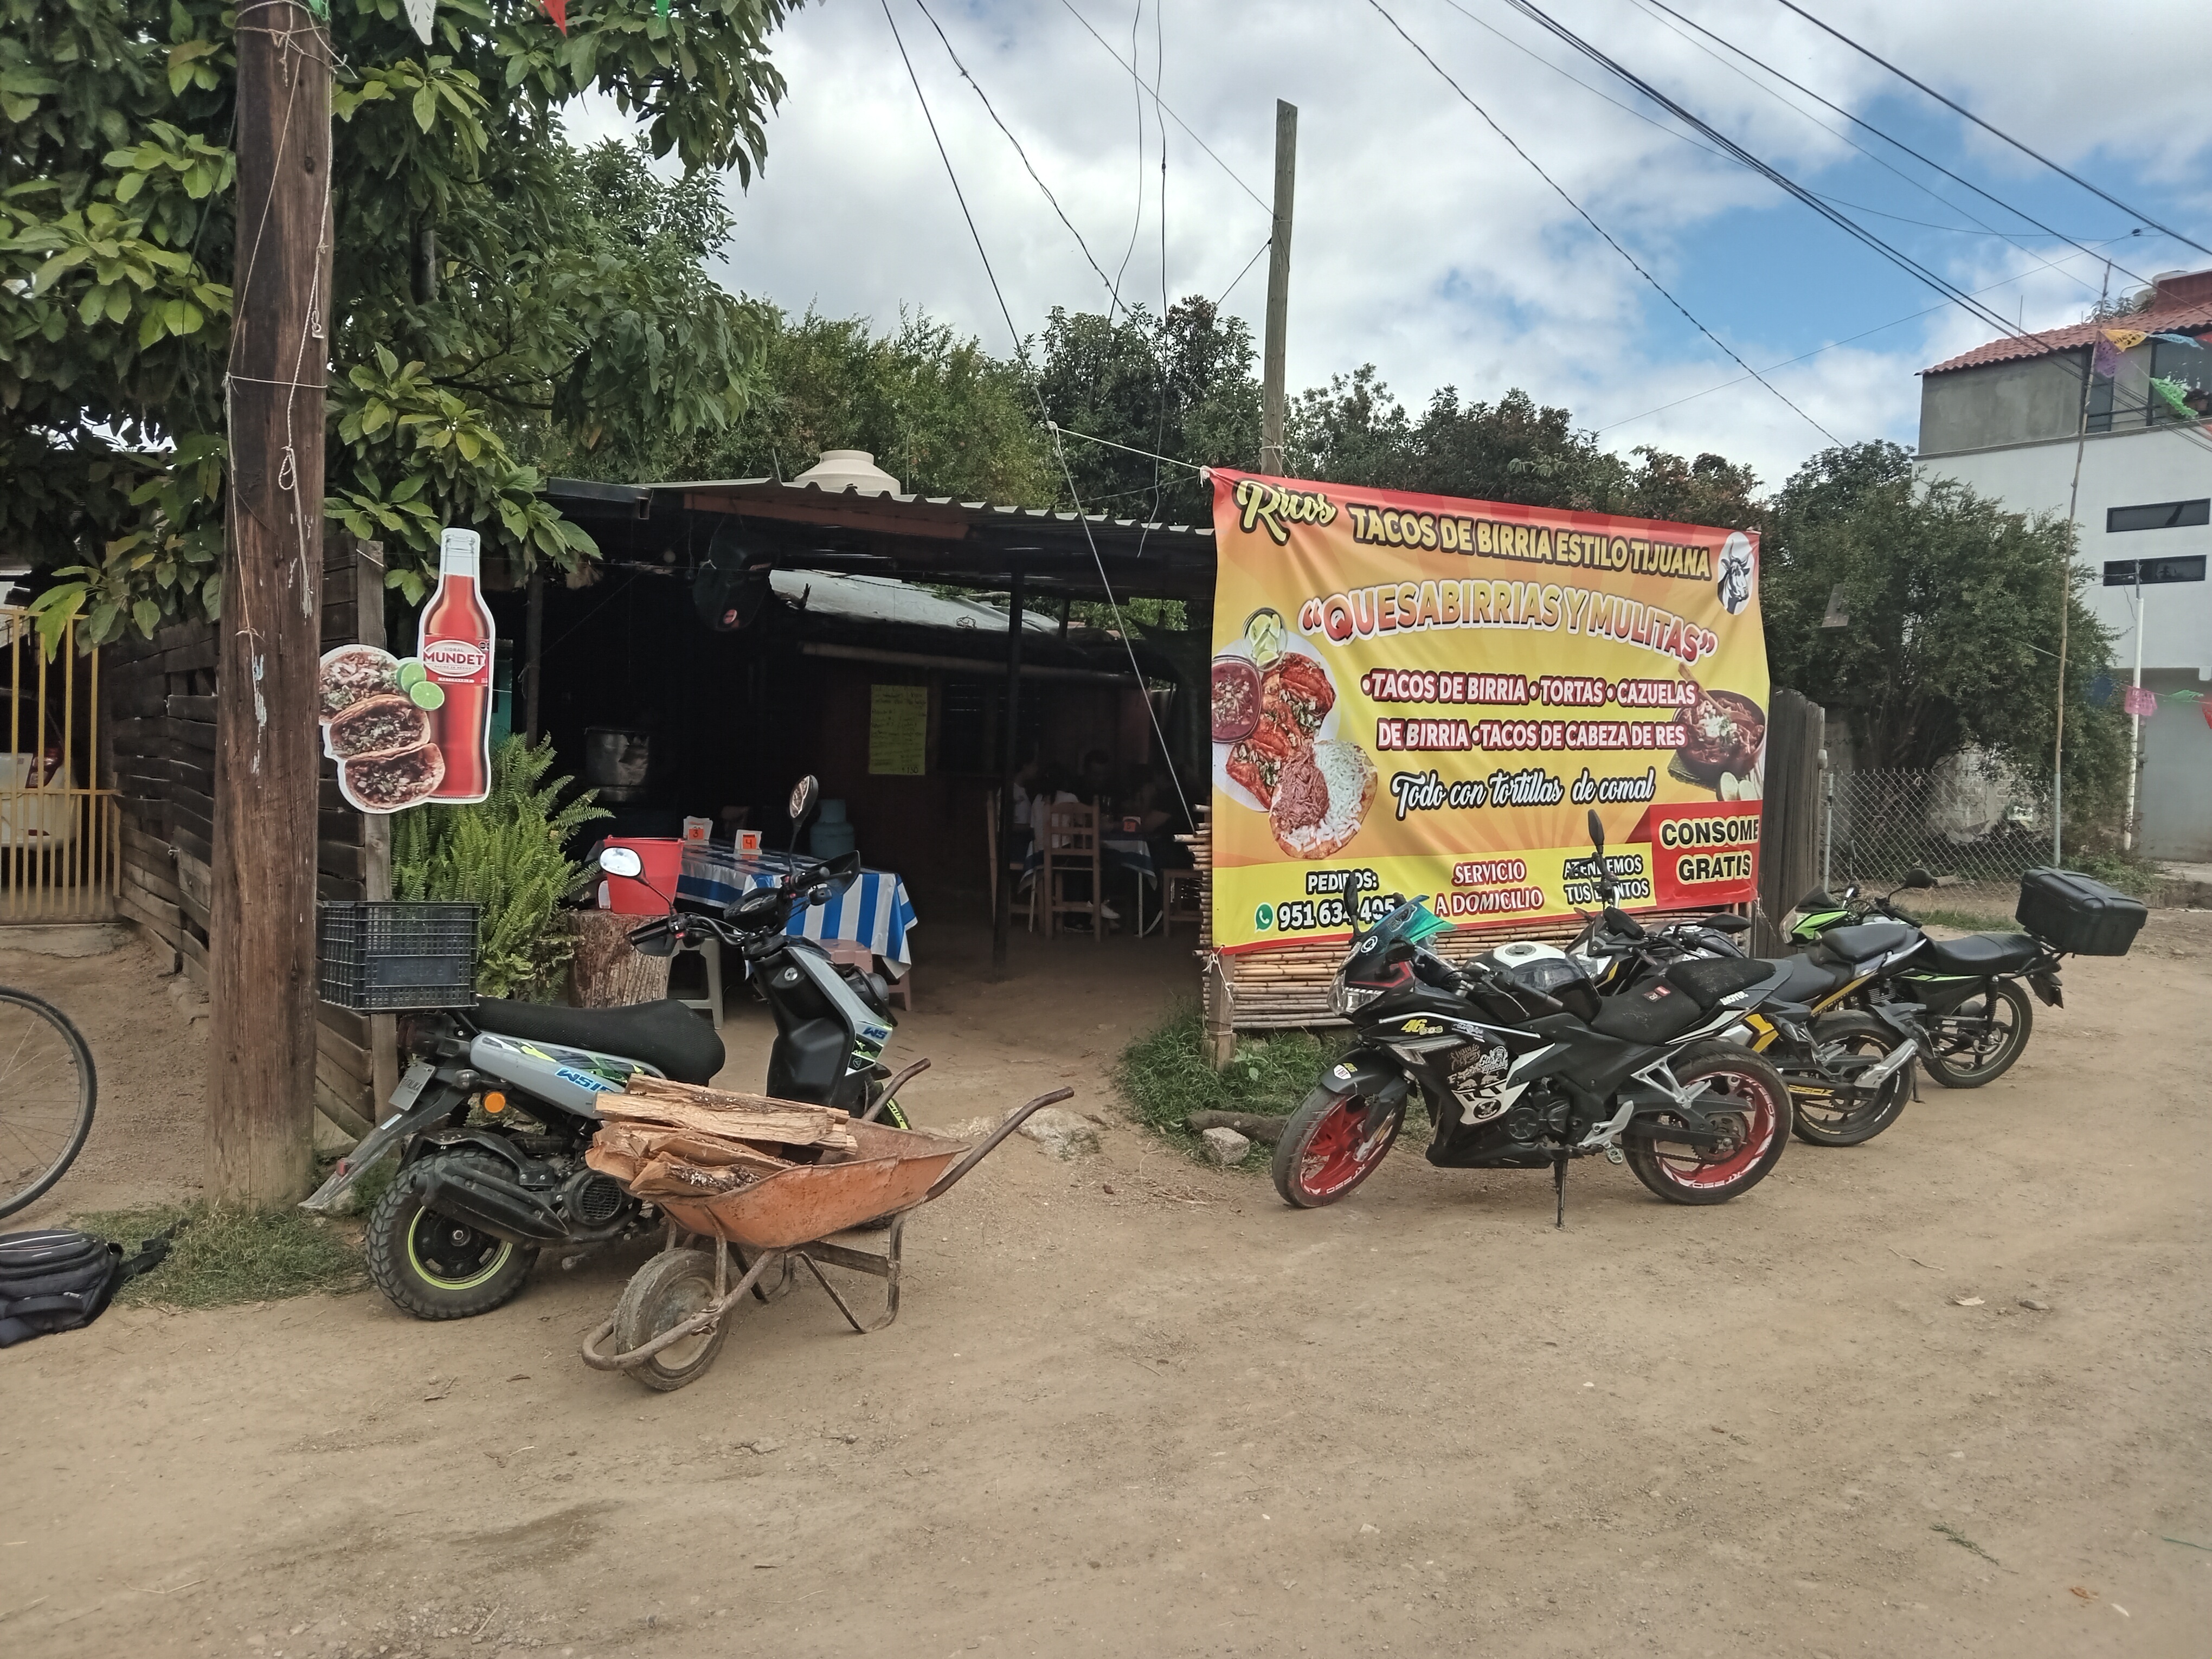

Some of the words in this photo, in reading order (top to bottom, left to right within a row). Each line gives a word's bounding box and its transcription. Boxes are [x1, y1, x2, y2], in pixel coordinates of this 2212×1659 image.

[1237, 480, 1336, 542] Ricos
[1348, 506, 1436, 547] TACOS
[1440, 519, 1474, 552] DE
[1476, 524, 1552, 561] BIRRIA
[1556, 532, 1627, 568] ESTILO
[1630, 543, 1711, 577] TIJUANA
[1567, 590, 1586, 631] Y
[423, 652, 483, 665] MUNDET
[1372, 673, 1435, 699] TACOS
[1440, 676, 1463, 699] DE
[1468, 677, 1526, 701] BIRRIA
[1540, 679, 1604, 703] TORTAS
[1616, 682, 1696, 704] CAZUELAS
[1378, 722, 1402, 746] DE
[1406, 723, 1469, 747] BIRRIA
[1480, 724, 1537, 747] TACOS
[1541, 724, 1562, 747] DE
[1565, 724, 1629, 746] CABEZA
[1631, 725, 1652, 746] DE
[1656, 725, 1686, 746] RES
[1392, 773, 1446, 818] Todo
[1449, 784, 1487, 806] con
[1572, 770, 1596, 801] de
[1599, 768, 1656, 801] comal
[692, 829, 699, 838] 3
[745, 839, 753, 848] 4
[1662, 818, 1759, 846] CONSOME
[1453, 861, 1526, 884] SERVICIO
[1564, 857, 1643, 878] ATENEMOS
[1679, 854, 1752, 880] GRATIS
[1436, 896, 1449, 915] A
[1452, 889, 1544, 914] DOMICILIO
[1565, 885, 1592, 902] TUS
[1279, 904, 1315, 928] 951
[862, 1026, 889, 1040] WS
[1401, 1019, 1427, 1033] 46
